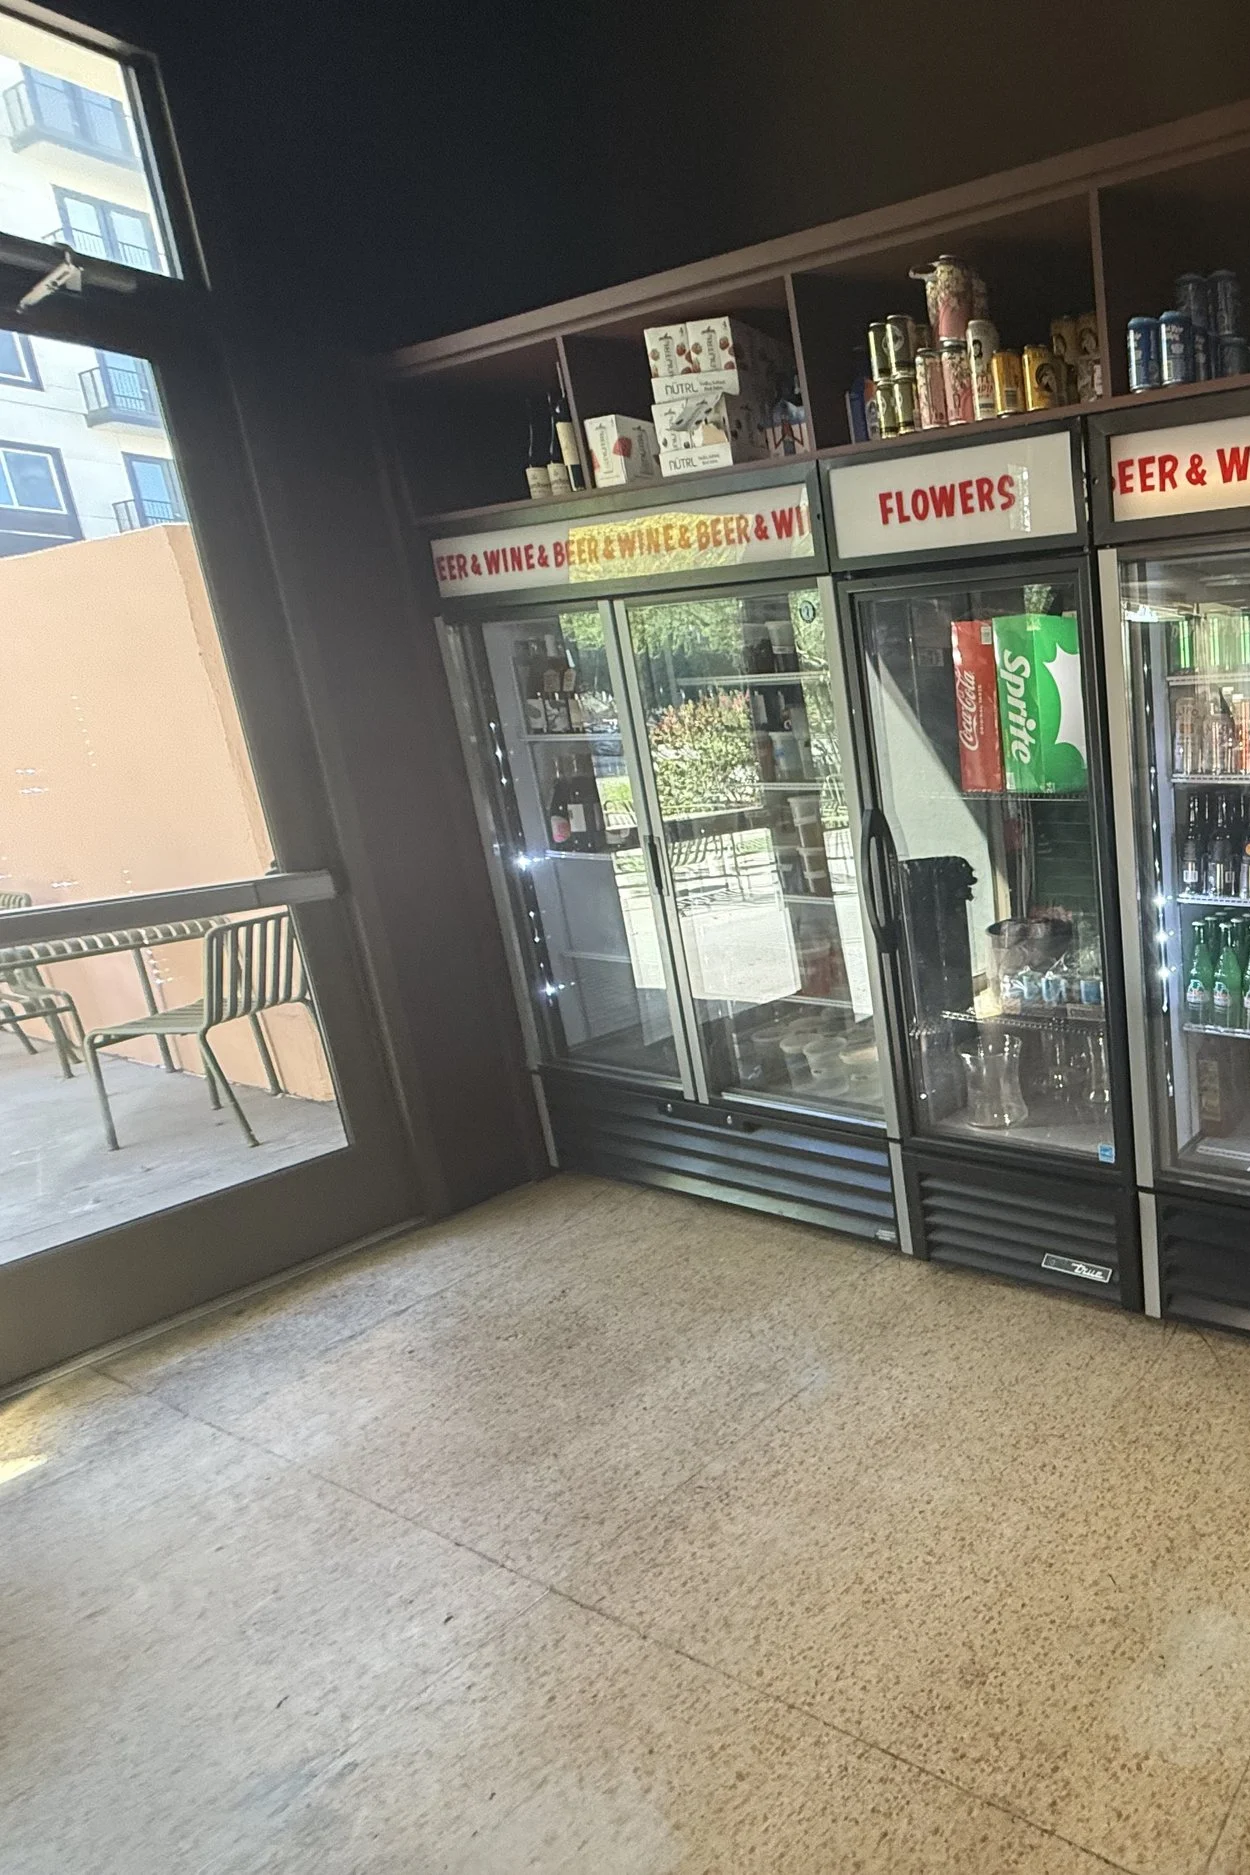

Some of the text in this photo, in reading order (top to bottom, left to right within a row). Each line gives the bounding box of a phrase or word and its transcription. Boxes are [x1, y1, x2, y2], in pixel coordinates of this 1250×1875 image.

[878, 473, 1017, 526] FLOWERS
[1110, 453, 1179, 495] EER
[1184, 452, 1208, 487] &
[434, 504, 812, 582] EER & WINE & BEER & WINE & BEER & WI
[1000, 648, 1037, 765] Sprite
[1071, 1263, 1105, 1279] True
